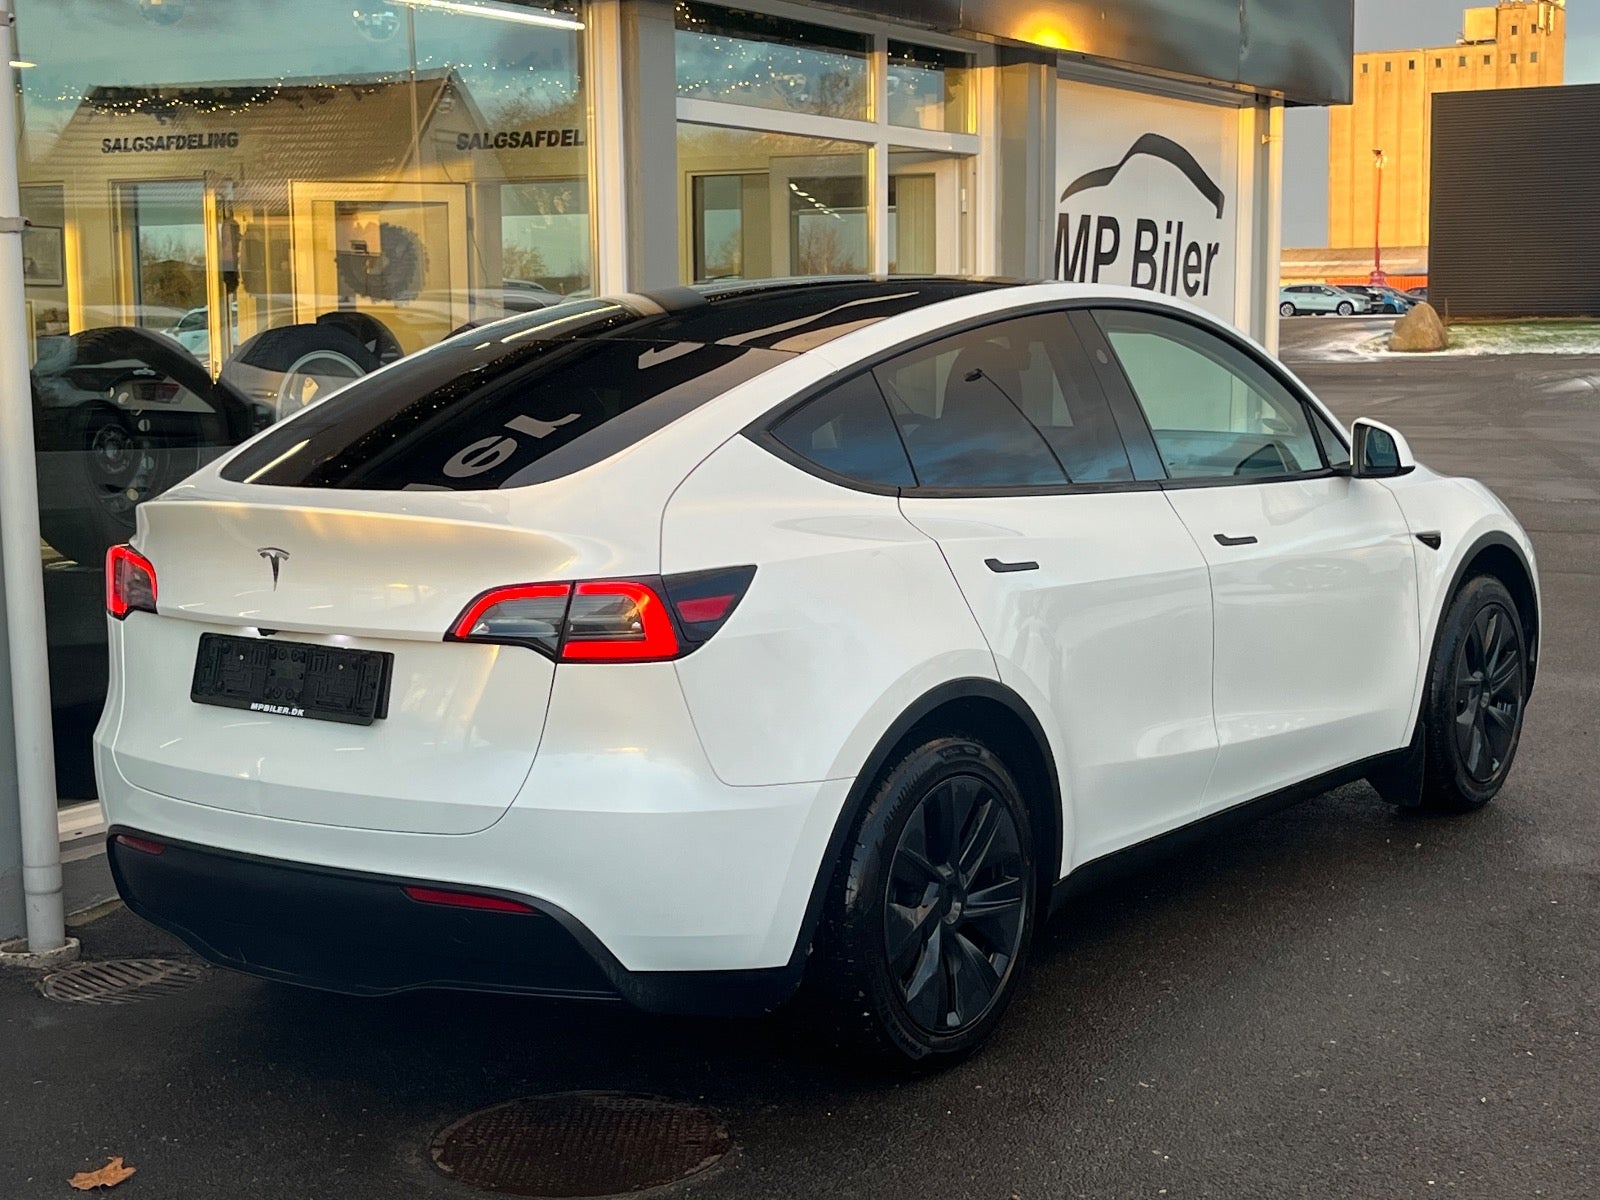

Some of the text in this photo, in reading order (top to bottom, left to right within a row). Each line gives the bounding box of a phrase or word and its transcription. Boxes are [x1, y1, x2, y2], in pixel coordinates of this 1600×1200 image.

[101, 132, 239, 153] SALGSAFDELING
[1055, 212, 1220, 298] MP Biler
[250, 702, 305, 717] MPBILER.DK
